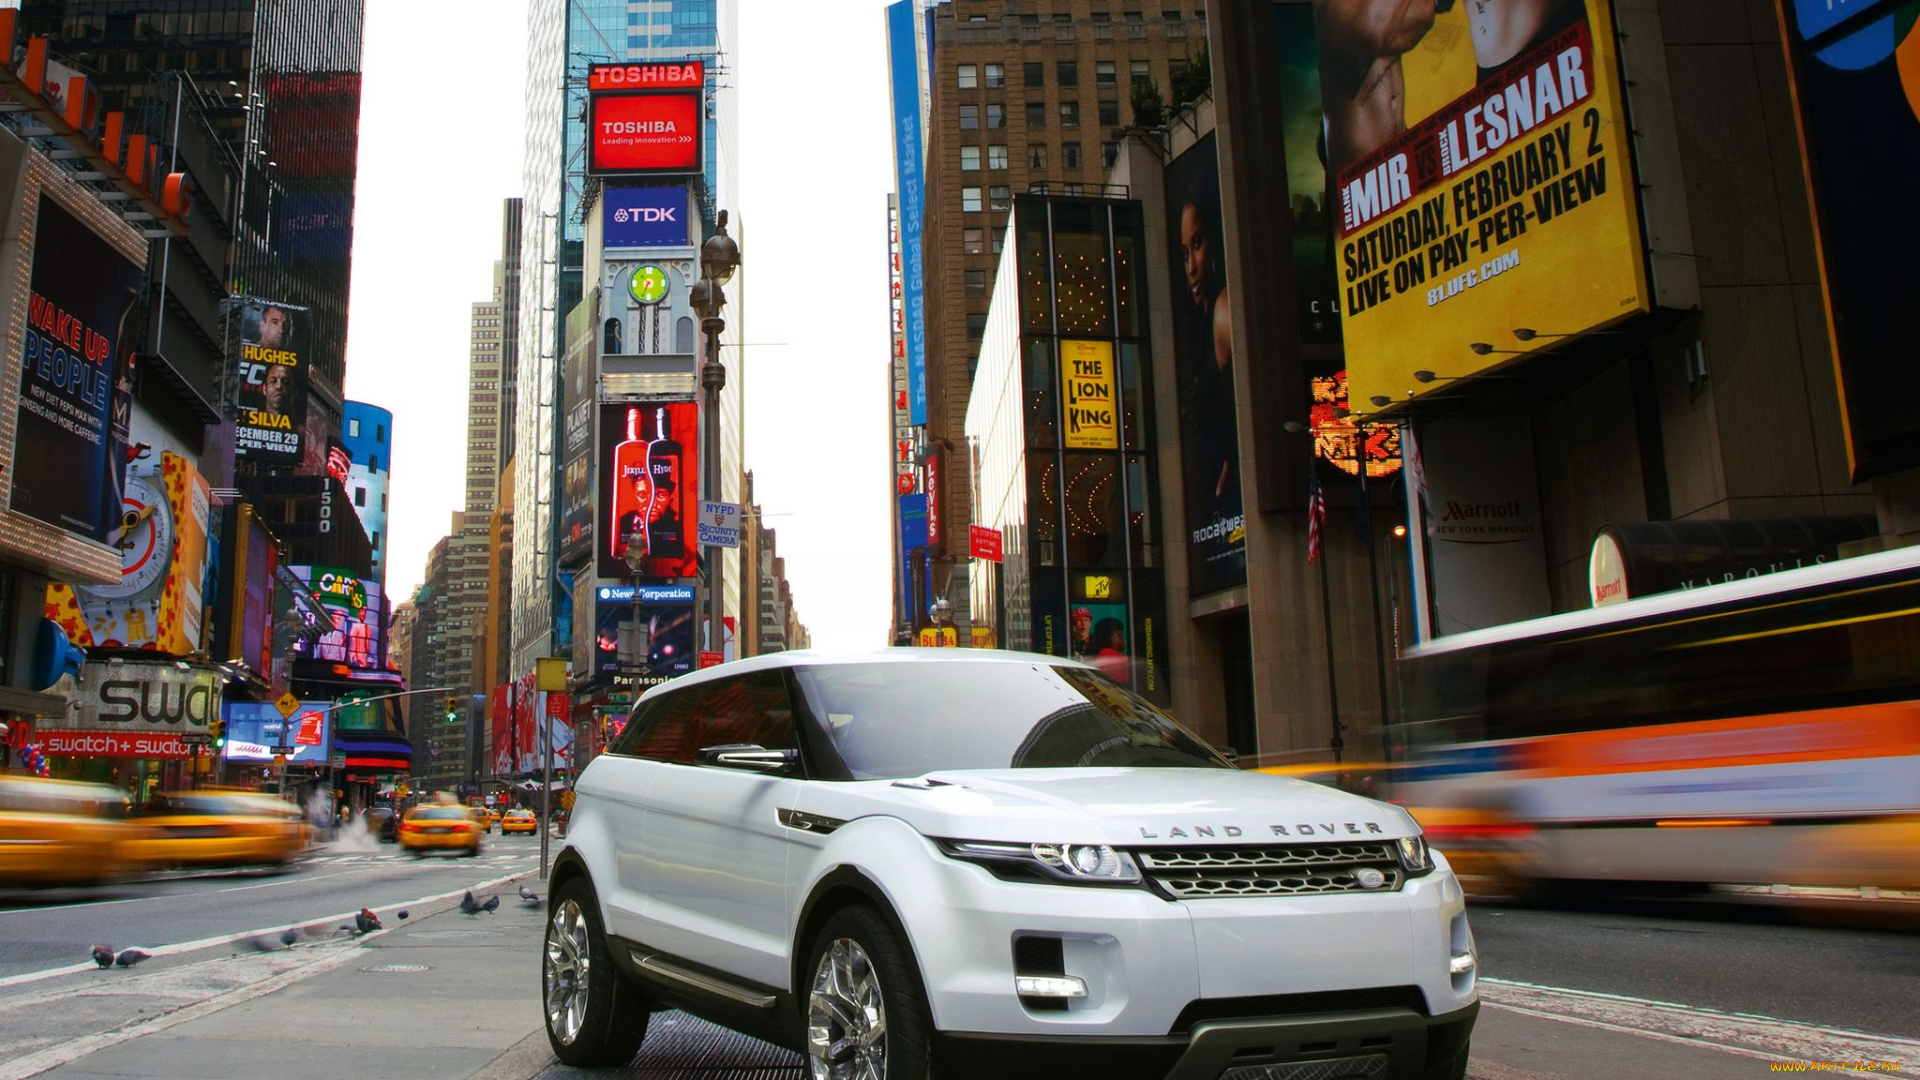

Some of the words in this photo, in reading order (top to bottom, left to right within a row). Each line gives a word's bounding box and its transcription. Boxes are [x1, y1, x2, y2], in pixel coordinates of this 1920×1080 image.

[595, 65, 697, 83] TOSHIBA
[1447, 46, 1588, 174] LESNAR
[602, 121, 676, 134] TOSHIBA
[602, 137, 633, 146] Leading
[635, 136, 677, 144] Innovation
[902, 114, 916, 176] Market
[1440, 128, 1450, 176] BROCK
[1344, 193, 1450, 283] SATURDAY,
[1452, 122, 1571, 227] FEBRUARY
[1583, 107, 1604, 158] 2
[1350, 153, 1411, 228] MIR
[629, 207, 676, 223] TDK
[906, 178, 920, 232] Select
[1342, 185, 1353, 231] FRANK
[1347, 269, 1391, 317] LIVE
[1393, 251, 1425, 295] ON
[1428, 156, 1607, 279] PAY-PER-VIEW
[908, 236, 923, 291] Global
[1426, 248, 1520, 307] 81.UFC.COM
[30, 290, 82, 352] WAKE
[84, 327, 110, 366] UP
[912, 296, 925, 369] NASDAQ
[244, 345, 297, 366] HUGHES
[1072, 360, 1103, 375] THE
[23, 327, 109, 411] PEOPLE
[1068, 379, 1109, 404] LION
[31, 384, 45, 400] NEW
[46, 389, 60, 406] DIET
[59, 399, 74, 416] PEPSI
[74, 407, 88, 422] MAX
[87, 413, 102, 430] WITH
[567, 399, 592, 435] PLANET
[45, 408, 58, 424] AND
[58, 415, 74, 432] MORE
[248, 410, 291, 430] SILVA
[1069, 407, 1111, 433] KING
[236, 426, 282, 443] ECEMBER
[284, 433, 299, 445] 29
[320, 478, 331, 533] 1500
[705, 503, 735, 515] NYPD
[1443, 500, 1521, 521] Marriott
[979, 529, 1001, 539] STOPPING
[1459, 525, 1486, 534] YORK
[1488, 525, 1537, 534] MARQUIS
[1085, 576, 1111, 596] MTV
[922, 634, 954, 647] BUBA
[48, 736, 117, 753] swatch
[1140, 825, 1242, 838] LAND
[1269, 822, 1383, 837] ROVER
